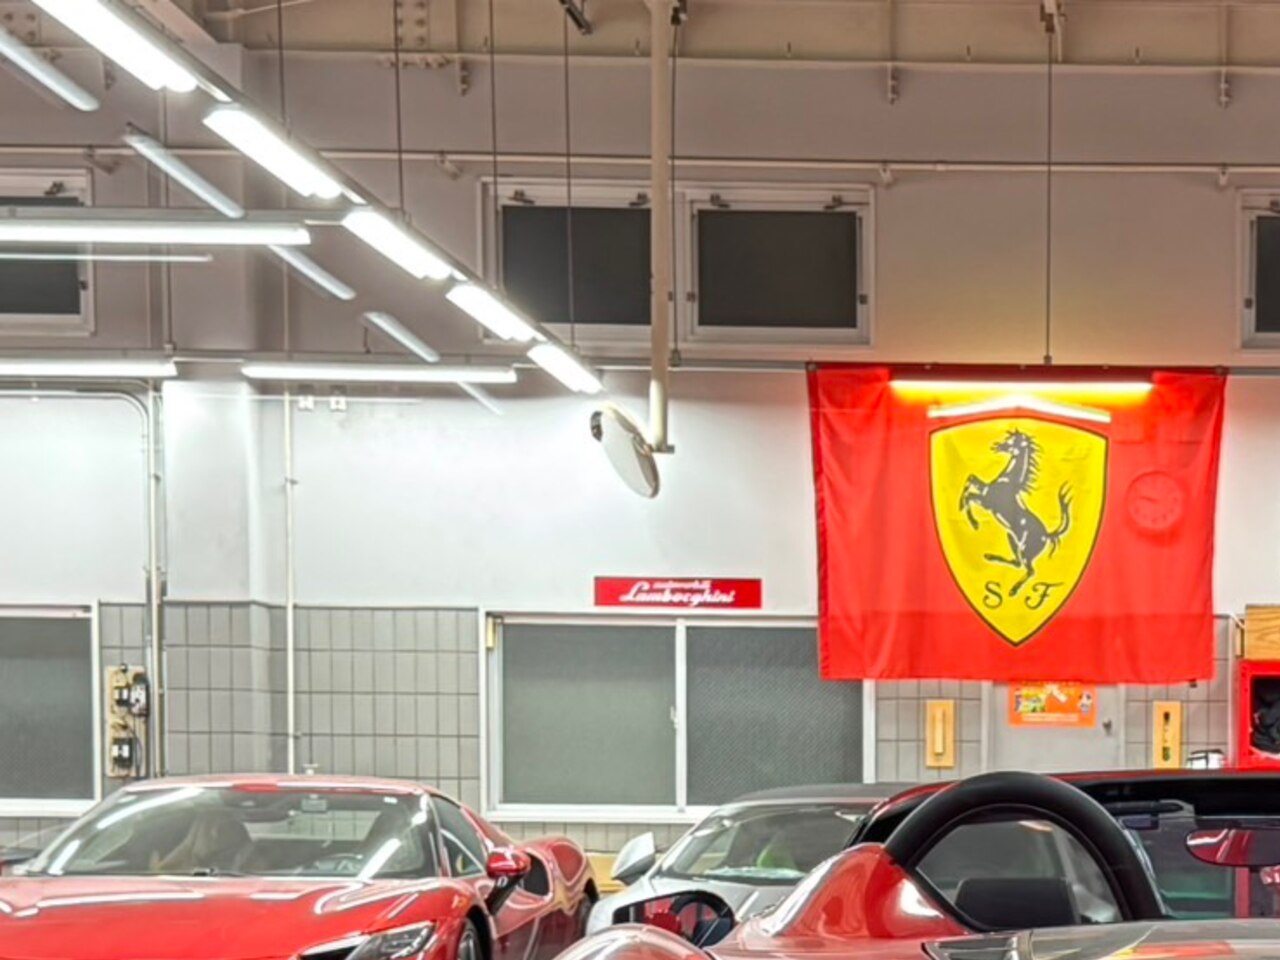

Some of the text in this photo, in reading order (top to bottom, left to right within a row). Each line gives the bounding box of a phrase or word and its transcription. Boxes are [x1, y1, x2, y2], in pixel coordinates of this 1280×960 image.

[619, 580, 736, 607] Lamborghini
[983, 580, 1065, 611] S F
